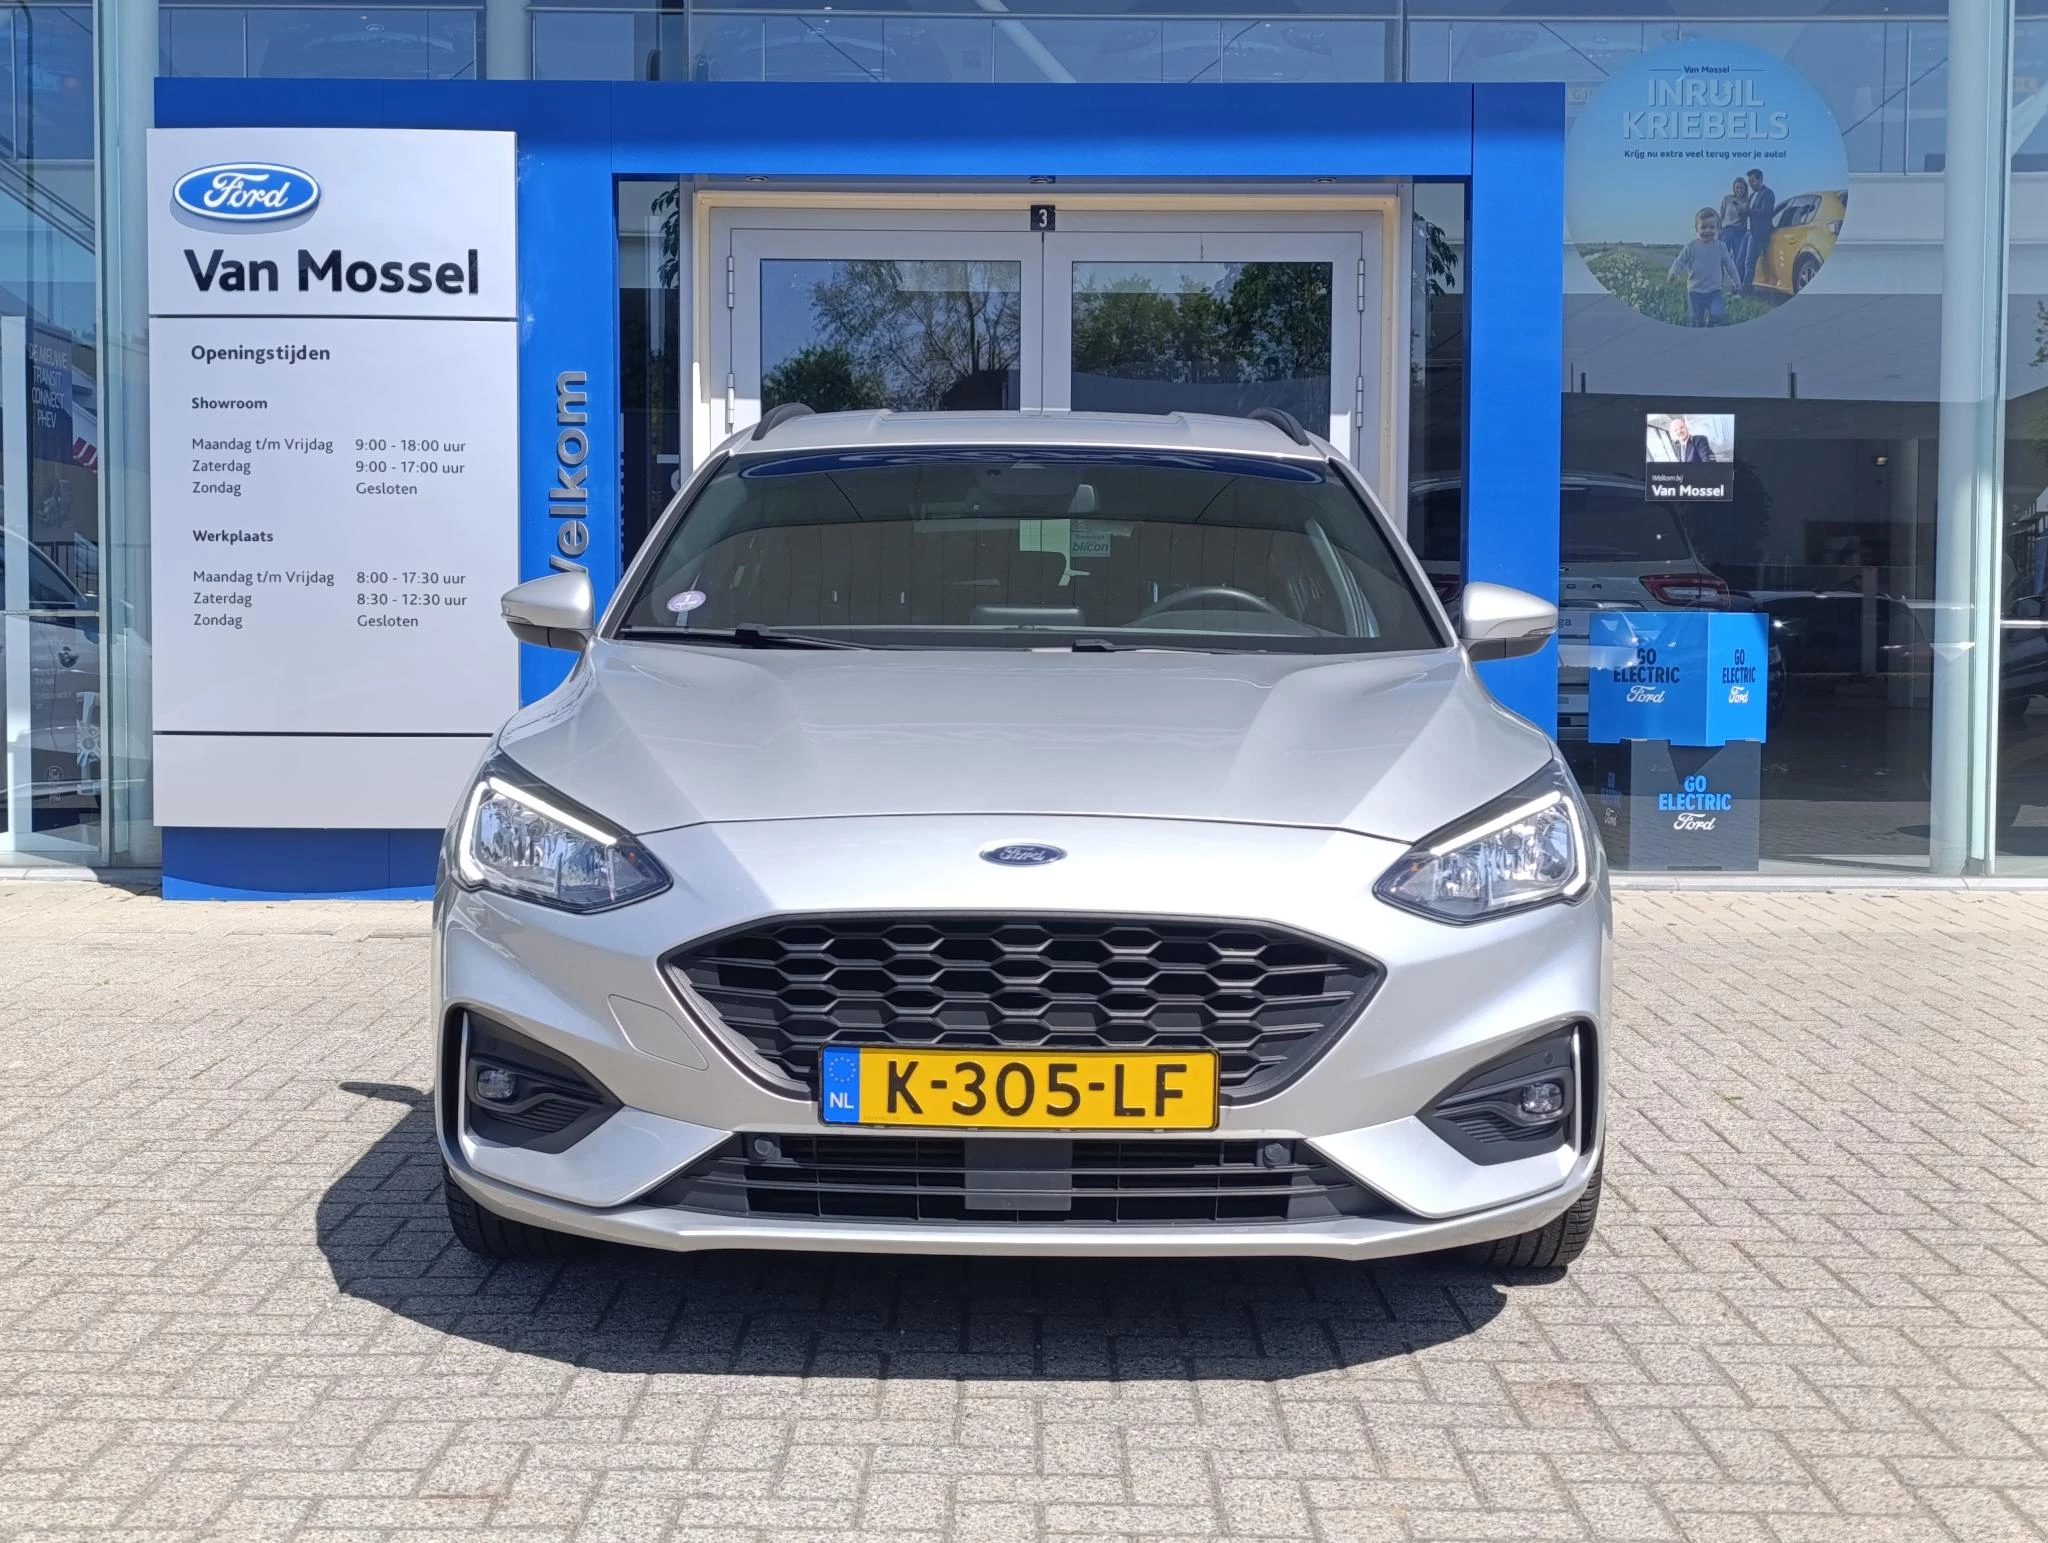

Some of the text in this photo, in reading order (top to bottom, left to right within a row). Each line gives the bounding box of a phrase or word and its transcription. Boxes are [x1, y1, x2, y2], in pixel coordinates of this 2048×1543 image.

[1684, 66, 1730, 74] Van Mossel
[1648, 79, 1766, 107] INRUIL
[1623, 111, 1790, 140] KRIEBELS
[1624, 150, 1645, 160] Krijg
[1660, 150, 1683, 158] extra
[1685, 150, 1704, 158] veel
[1705, 150, 1730, 160] terug
[1753, 150, 1762, 160] je
[1764, 150, 1787, 158] auto!
[204, 172, 291, 208] Ford
[1039, 209, 1048, 227] 3
[183, 249, 478, 295] Van Mossel
[40, 347, 68, 369] NIEUWE
[191, 344, 331, 364] Openingstijden
[32, 365, 62, 388] TRANSIT
[31, 387, 65, 409] CONNECT
[192, 396, 267, 410] Showroom
[37, 409, 57, 429] PHEV
[192, 437, 252, 454] Maandag
[256, 437, 281, 451] t/m
[284, 437, 333, 454] Vrijdag
[356, 439, 387, 451] 9:00
[401, 440, 439, 452] 18:00
[443, 443, 466, 452] uur
[192, 459, 251, 475] Zaterdag
[356, 461, 387, 473] 9:00
[401, 461, 438, 473] 17:00
[442, 464, 465, 474] uur
[550, 371, 589, 574] elkom
[1652, 474, 1676, 482] Welkom
[192, 481, 418, 497] Zondag Gesloten
[1651, 484, 1725, 497] Van Mossel
[193, 529, 274, 545] Werkplaats
[194, 570, 254, 587] Maandag
[257, 570, 282, 584] t/m
[285, 570, 335, 587] Vrijdag
[357, 571, 388, 584] 8:00
[402, 572, 439, 584] 17:30
[444, 575, 466, 585] uur
[194, 592, 253, 608] Zaterdag
[357, 593, 388, 606] 8:30
[402, 594, 440, 606] 12:30
[444, 597, 467, 606] uur
[194, 613, 419, 630] Zondag Gesloten
[1637, 648, 1657, 665] GO
[1734, 649, 1745, 665] GO
[1613, 667, 1680, 684] ELECTRIC
[1722, 666, 1756, 684] ELECTRIC
[1627, 685, 1665, 704] Ford
[1728, 685, 1750, 704] Ford
[1684, 775, 1707, 793] GO
[1658, 794, 1733, 811] ELECTRIC
[1673, 812, 1716, 831] Ford
[1000, 847, 1046, 861] Ford
[887, 1060, 1187, 1117] K-305-LF
[830, 1091, 855, 1109] NL
